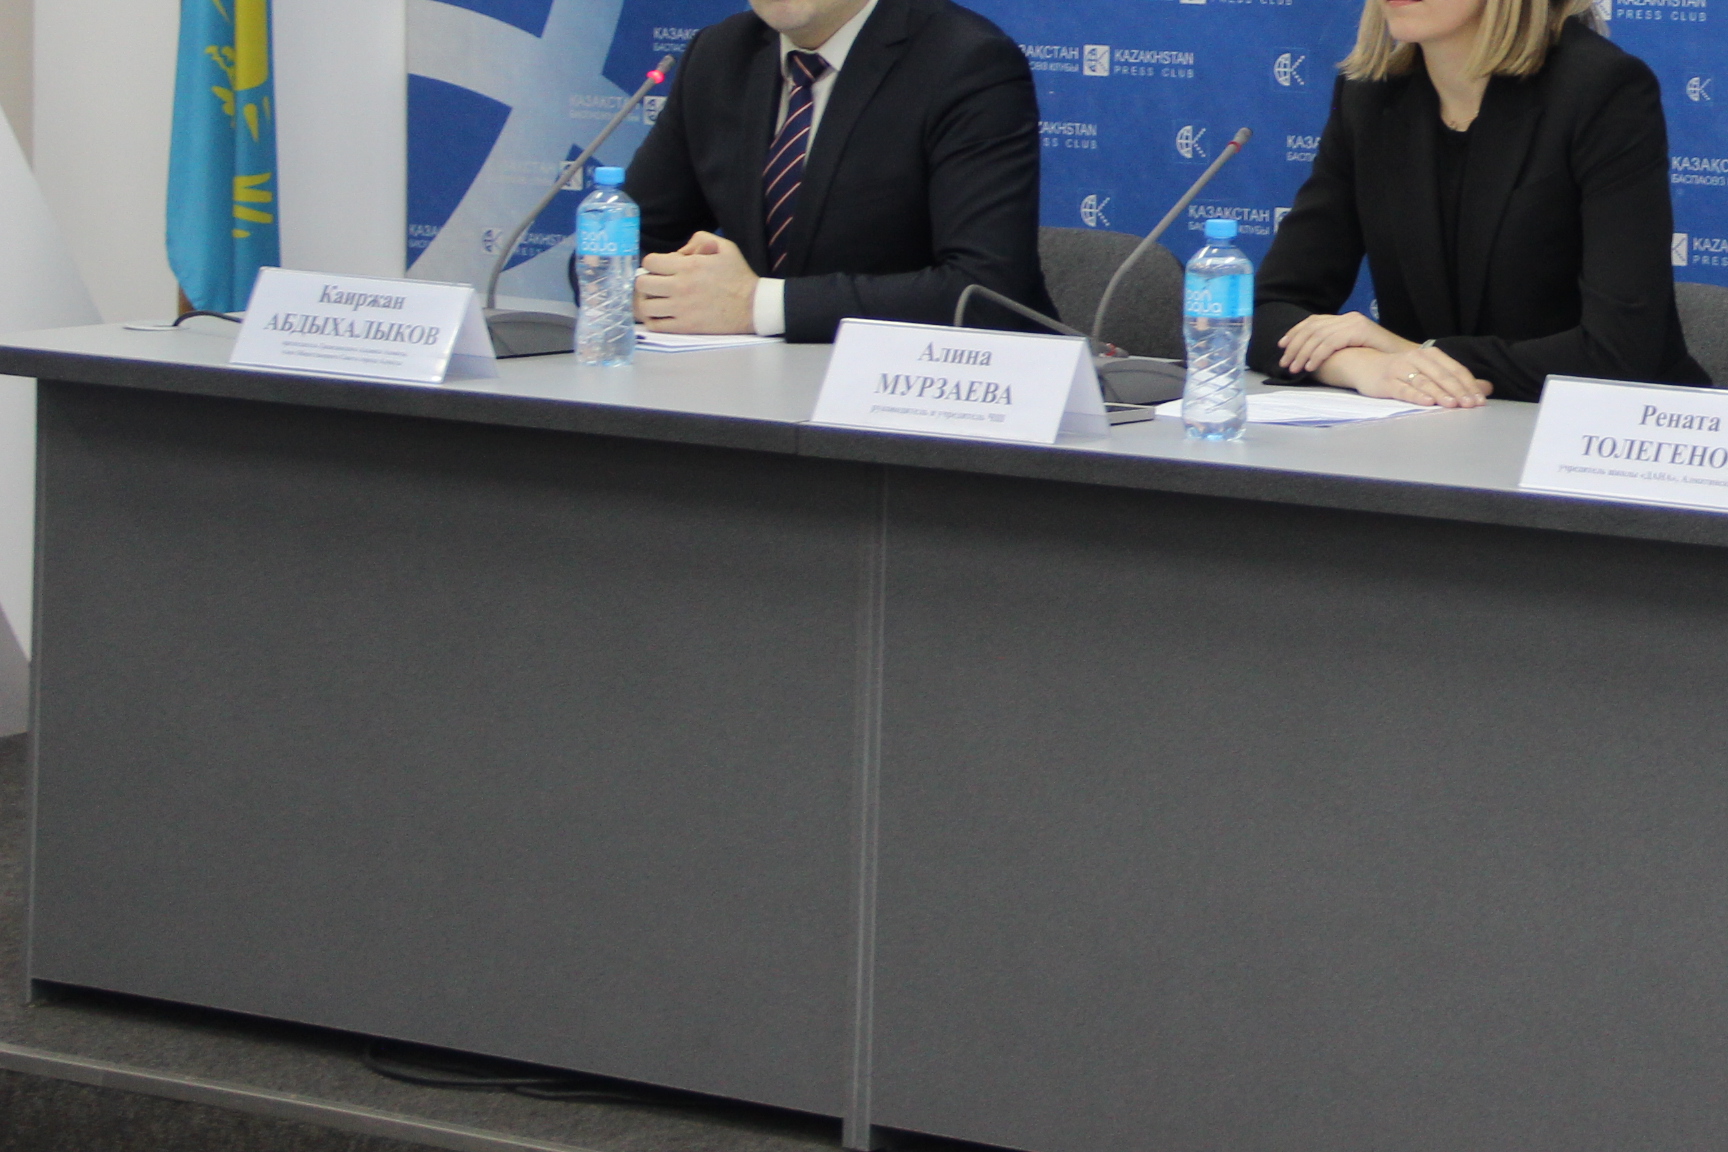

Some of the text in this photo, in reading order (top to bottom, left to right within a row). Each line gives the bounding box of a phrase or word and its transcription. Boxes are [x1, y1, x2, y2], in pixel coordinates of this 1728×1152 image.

[1114, 49, 1195, 66] KAZAKHSTAN
[263, 312, 441, 346] АБДЫХАЛЫКОВ
[917, 341, 993, 367] Алина
[874, 372, 1013, 406] МУРЗАЕВА
[1639, 404, 1722, 433] Рената
